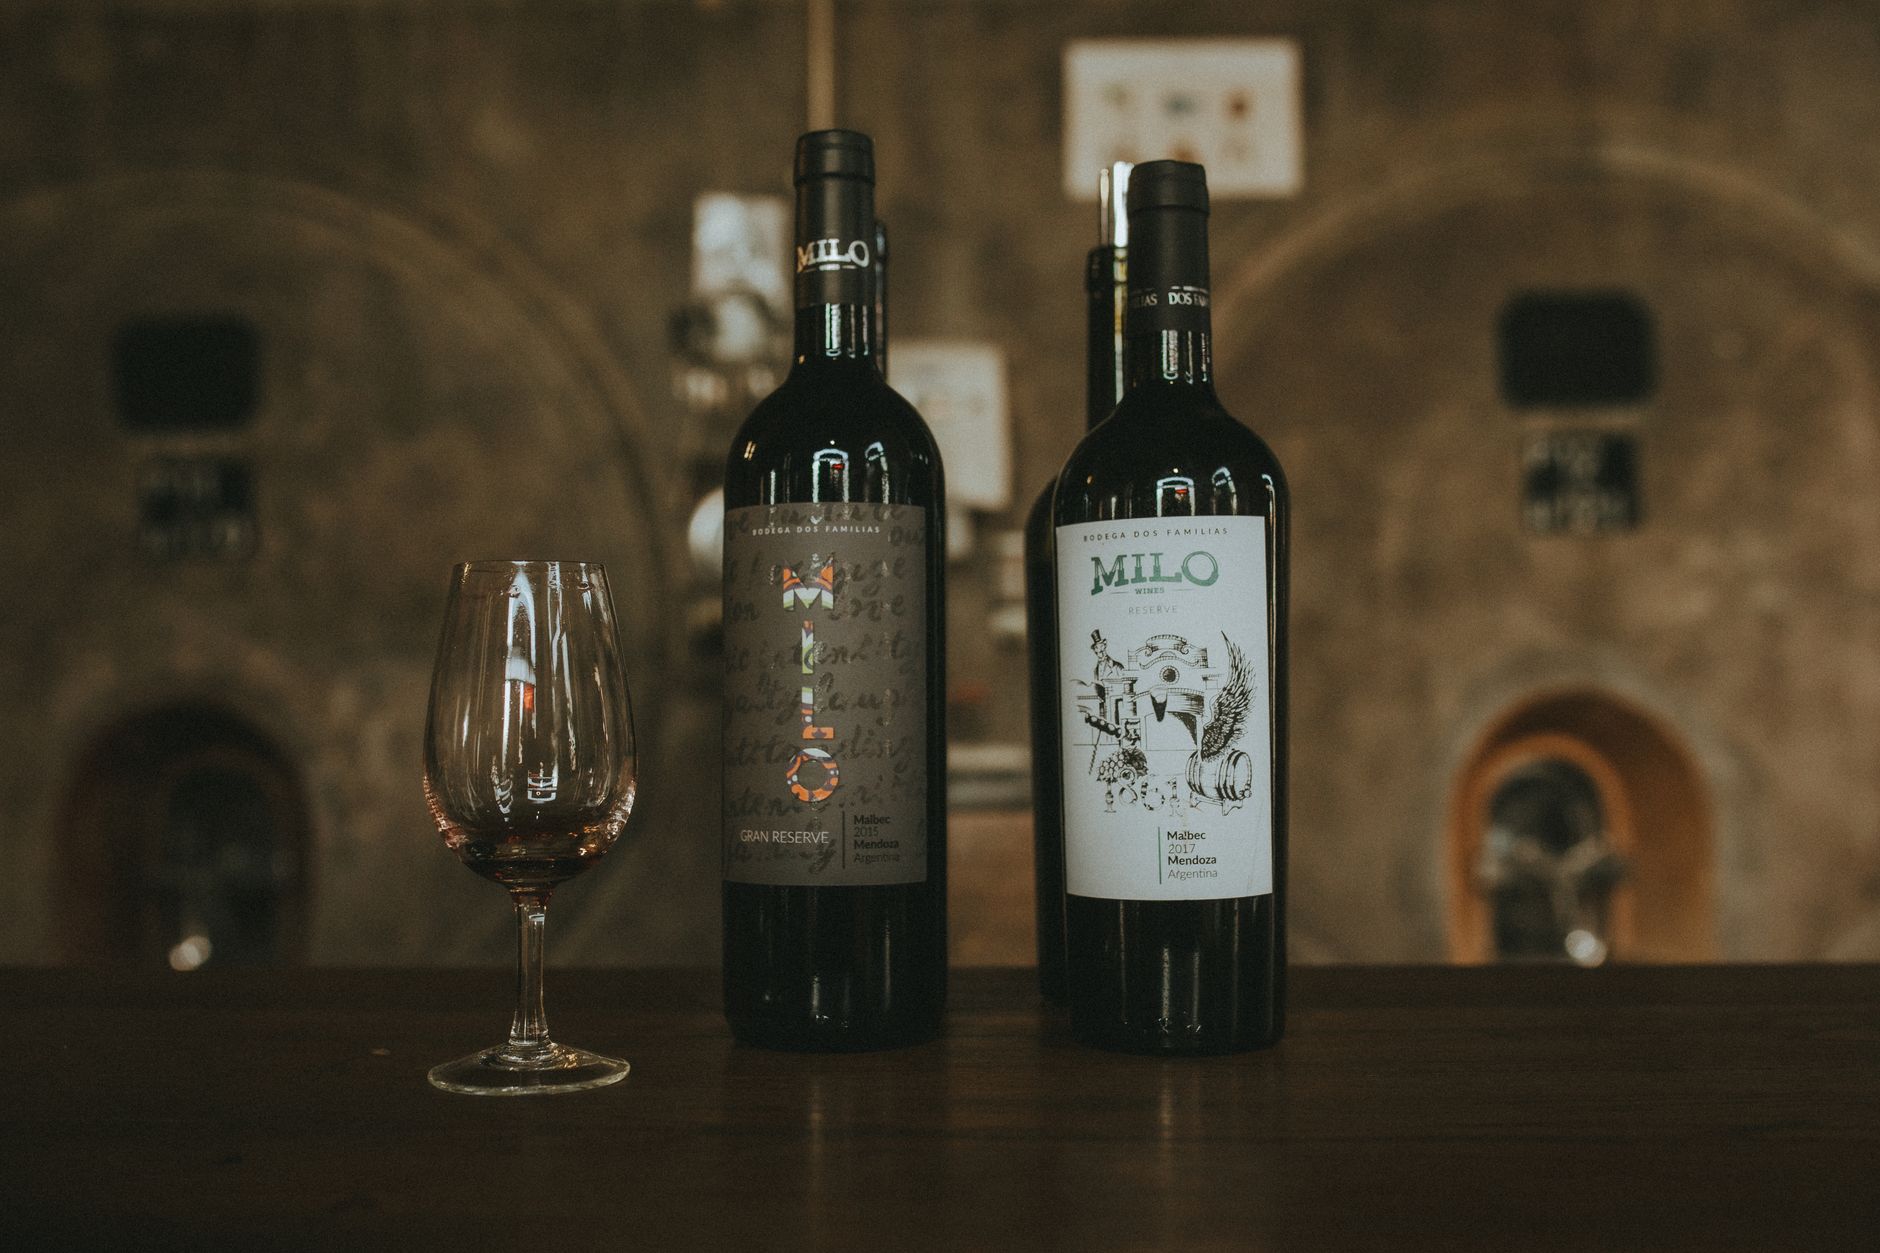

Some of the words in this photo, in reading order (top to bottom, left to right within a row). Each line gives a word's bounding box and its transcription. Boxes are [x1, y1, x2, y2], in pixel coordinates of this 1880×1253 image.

[796, 238, 870, 274] MILO
[1168, 291, 1193, 306] DOS
[752, 527, 790, 536] BODEGA
[1083, 532, 1126, 542] BODEGA
[1133, 530, 1158, 538] DOS
[1166, 528, 1229, 536] FAMILIAS
[1090, 551, 1219, 596] MILO
[1135, 587, 1165, 595] WINES
[1128, 606, 1178, 614] RESERVE
[783, 553, 840, 802] MILO
[854, 814, 891, 825] Malbec
[740, 830, 769, 843] GRAN
[772, 831, 830, 844] RESERVE
[854, 826, 879, 838] 2015
[1167, 830, 1206, 841] Malbec
[854, 839, 899, 850] Mendoza
[1168, 843, 1196, 854] 2017
[1167, 855, 1217, 866] Mendoza
[1167, 868, 1218, 880] Argentina
